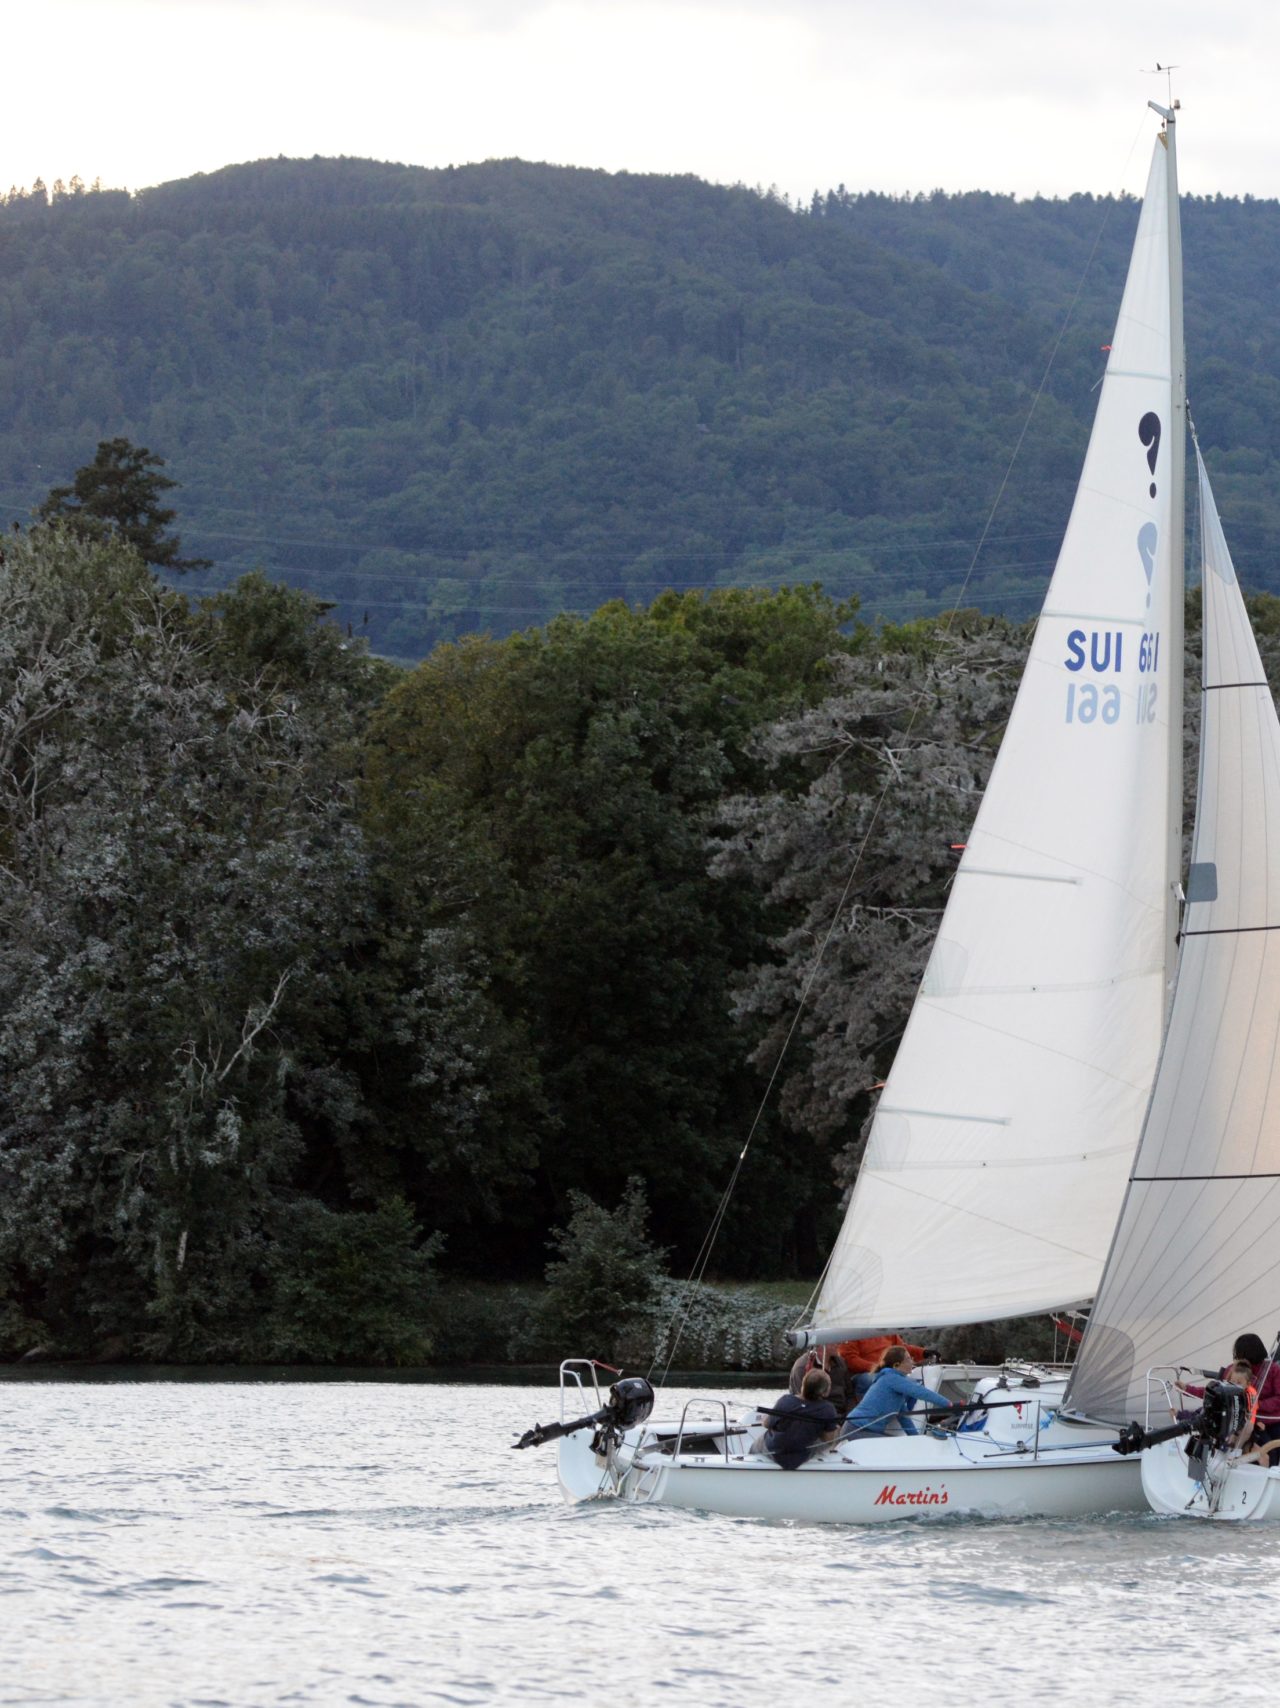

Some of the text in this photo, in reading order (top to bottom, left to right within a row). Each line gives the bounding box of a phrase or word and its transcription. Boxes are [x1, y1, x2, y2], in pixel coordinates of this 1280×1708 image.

[1064, 629, 1160, 673] SUI 661
[873, 1483, 949, 1505] Martin's
[1241, 1490, 1247, 1505] 2
